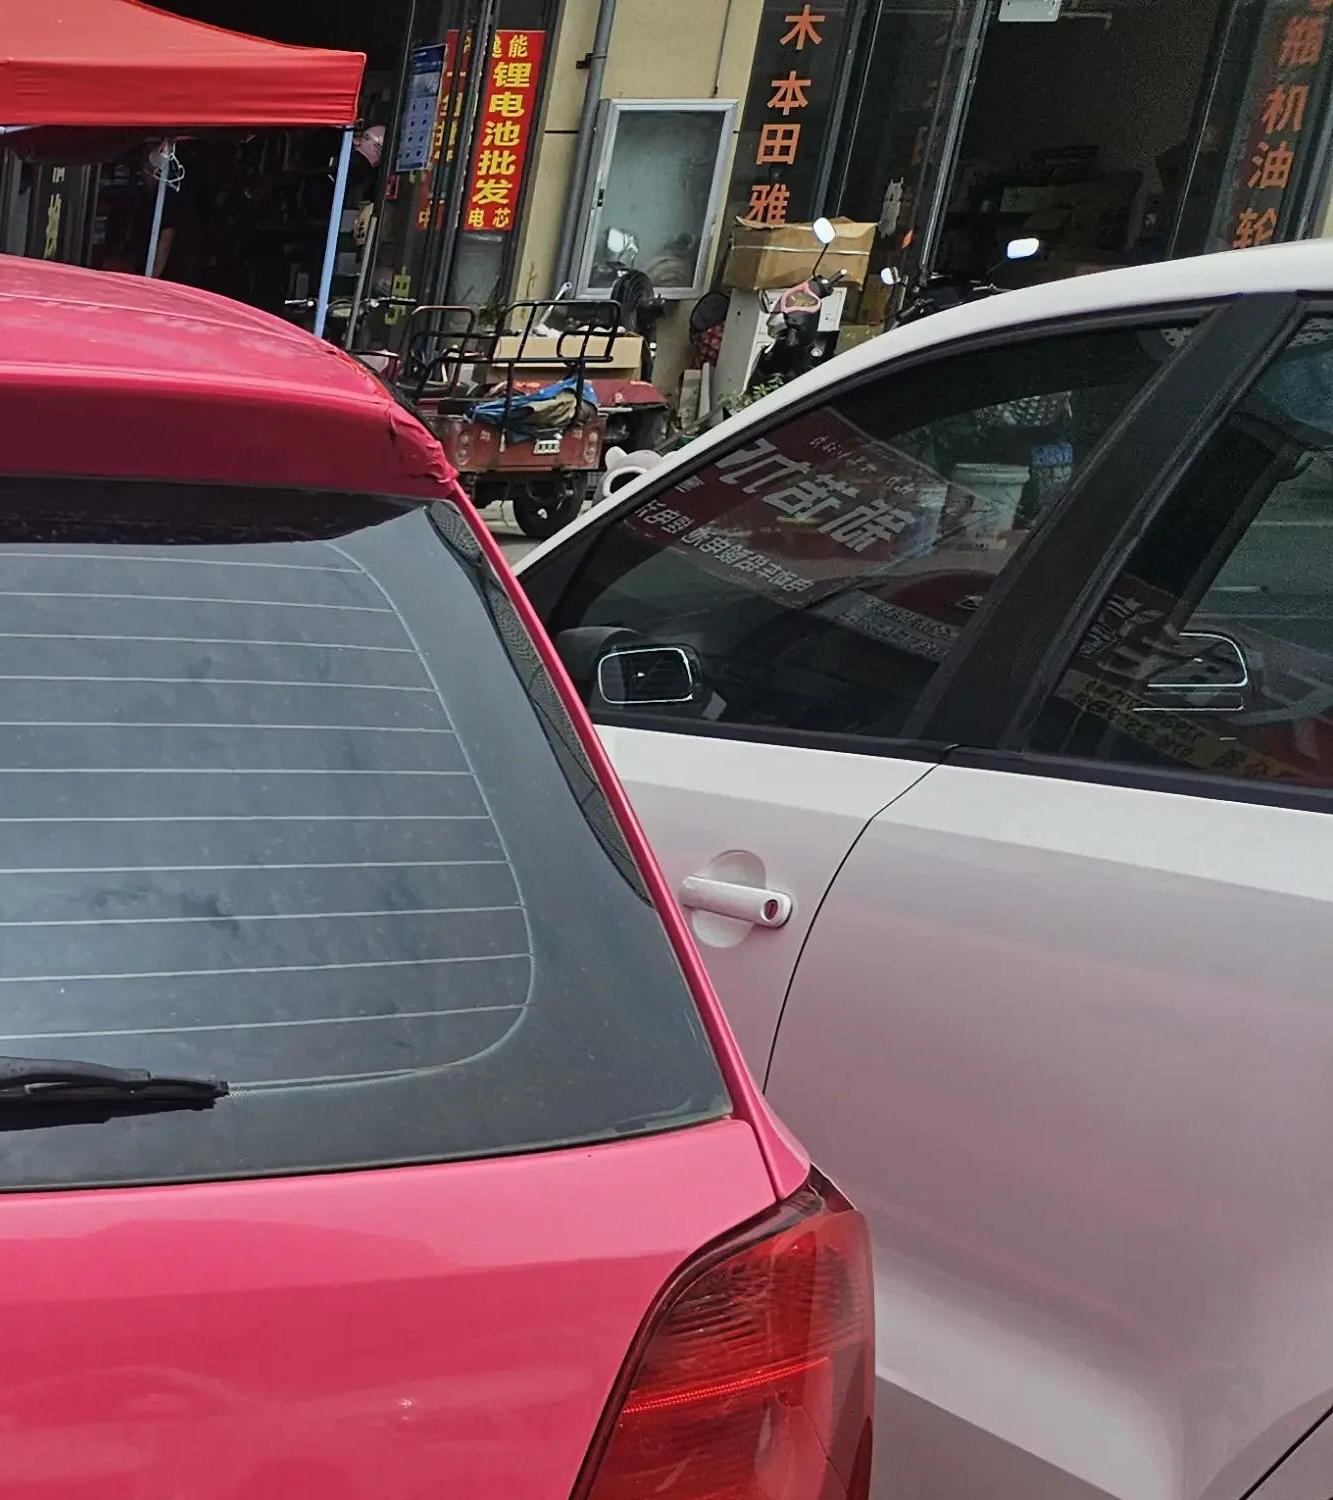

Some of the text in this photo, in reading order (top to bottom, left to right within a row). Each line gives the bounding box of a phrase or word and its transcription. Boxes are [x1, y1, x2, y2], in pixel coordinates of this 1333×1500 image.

[472, 61, 532, 205] 锂电池批发
